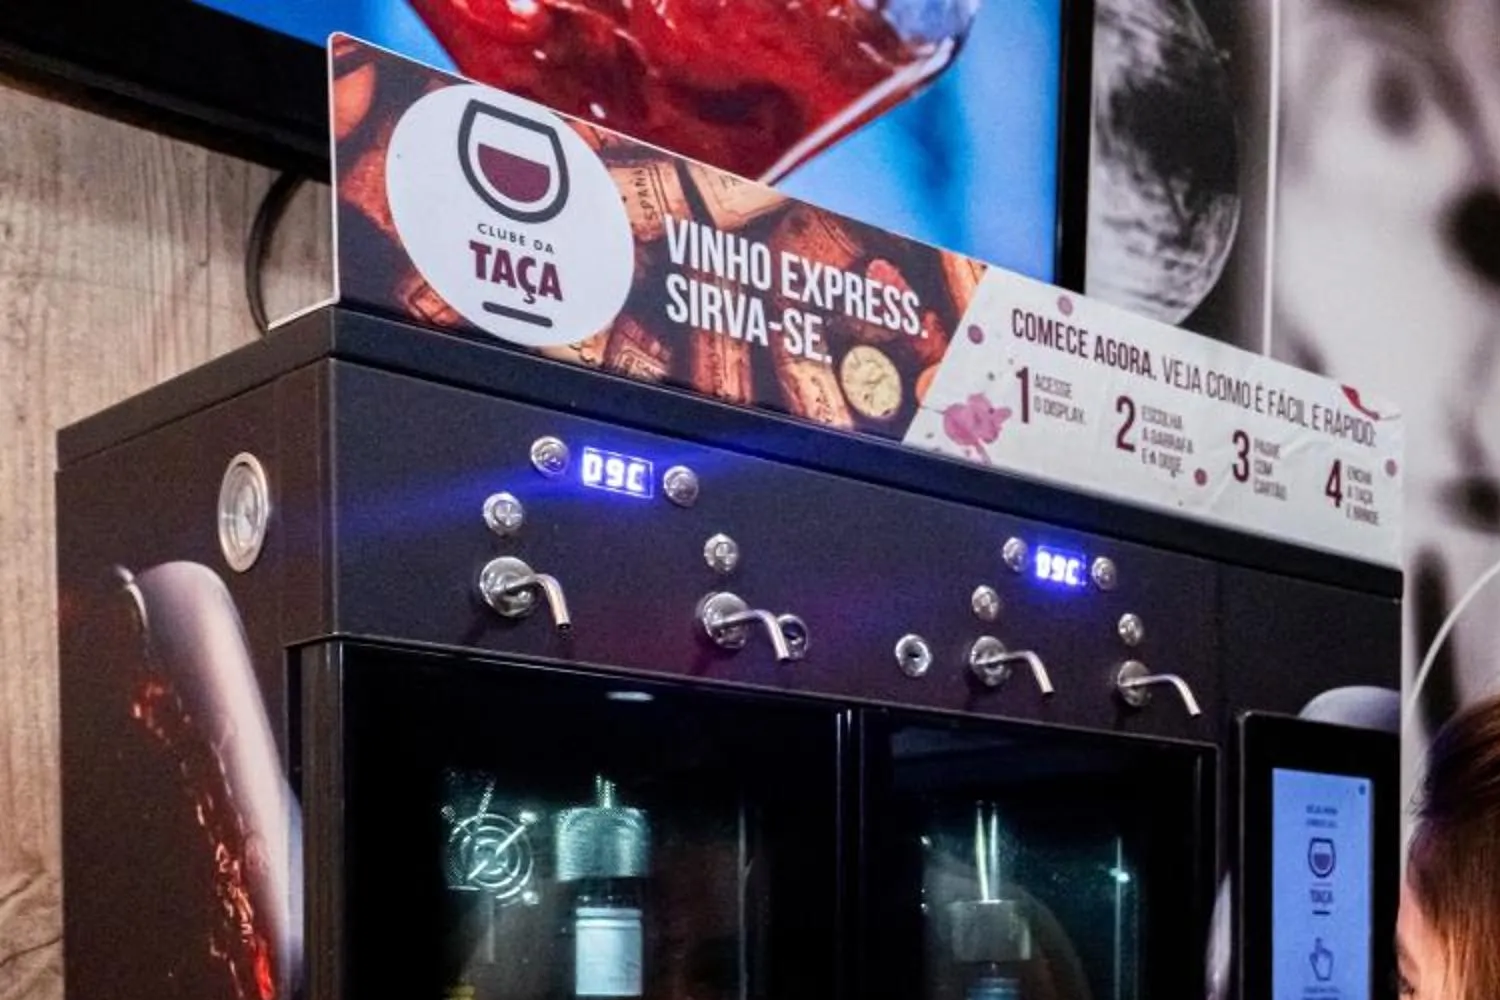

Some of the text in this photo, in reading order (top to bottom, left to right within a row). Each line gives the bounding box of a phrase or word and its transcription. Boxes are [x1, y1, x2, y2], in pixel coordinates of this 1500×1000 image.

[477, 223, 555, 255] CLUBE DA
[468, 240, 563, 304] TAÇA
[664, 213, 929, 339] VINHO EXPRESS.
[665, 273, 834, 365] SIRVA-SE.
[1012, 308, 1089, 359] COMECE
[1094, 335, 1158, 381] AGORA.
[1162, 356, 1202, 394] VEJA
[1206, 371, 1251, 409] COMO
[1268, 389, 1309, 427] FÁCIL
[1324, 409, 1377, 447] RÁPIDO:
[1015, 365, 1030, 424] 1
[1115, 395, 1137, 453] 2
[1232, 429, 1250, 483] 3
[1324, 458, 1343, 509] 4
